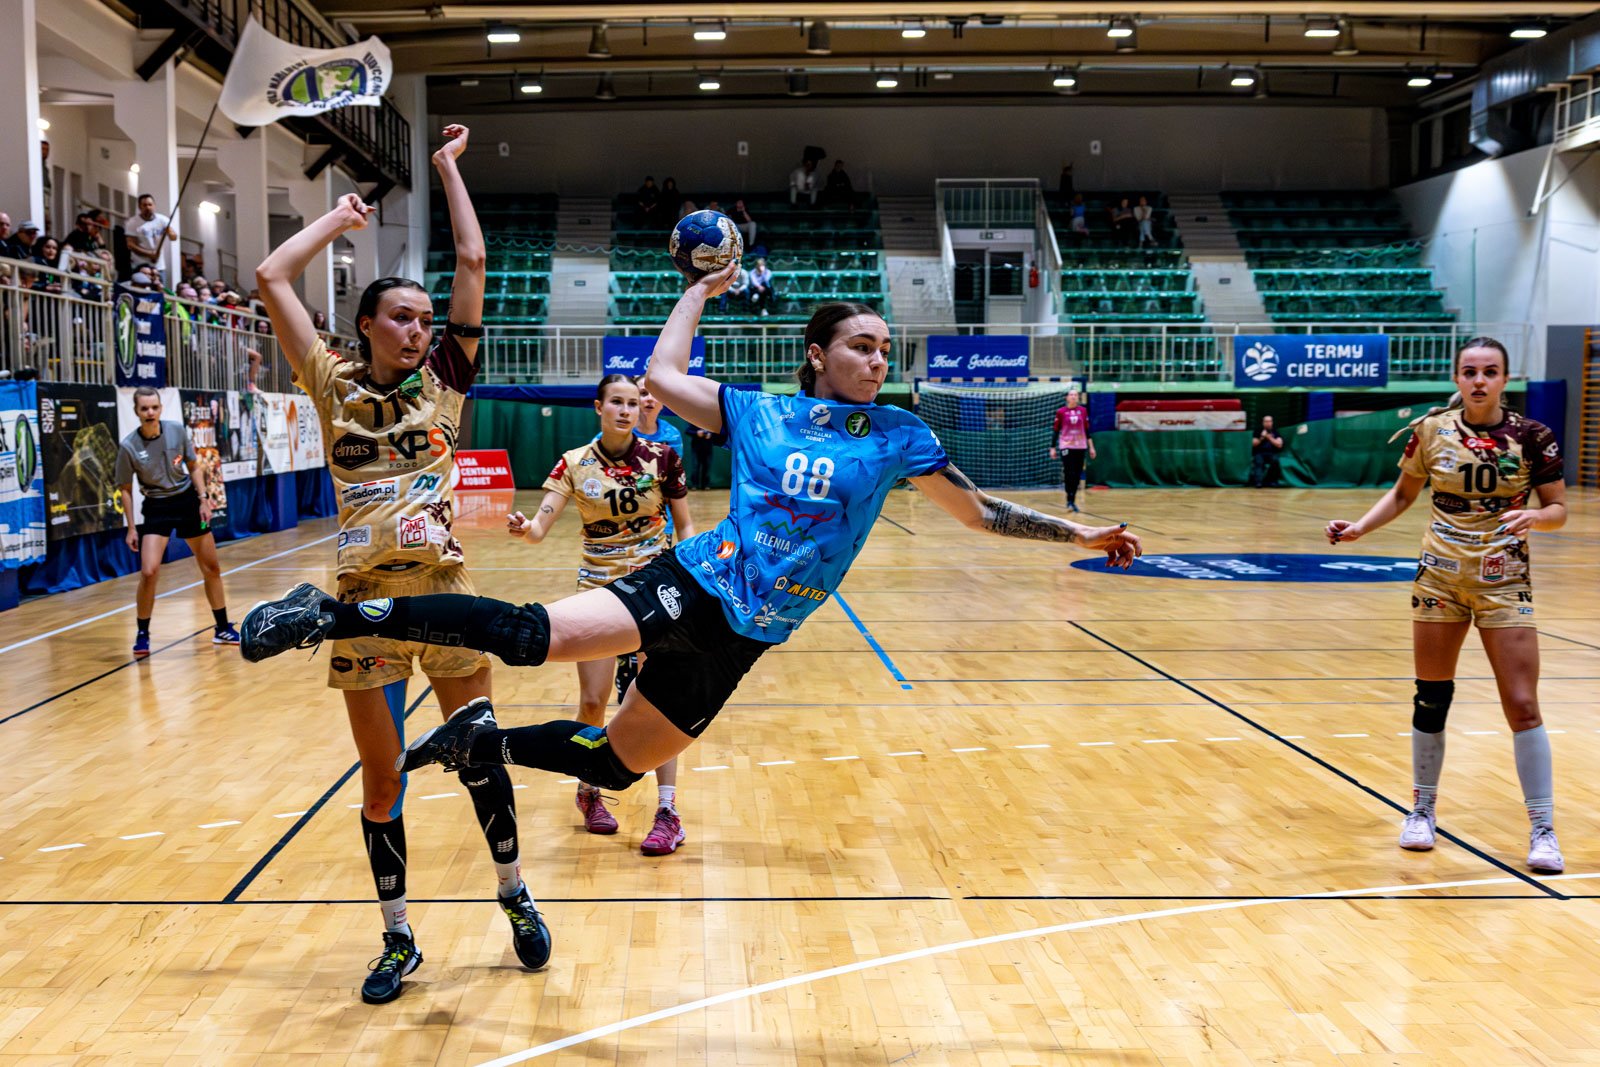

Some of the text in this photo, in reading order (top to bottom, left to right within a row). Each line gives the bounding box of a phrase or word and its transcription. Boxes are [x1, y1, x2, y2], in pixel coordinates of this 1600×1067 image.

[1304, 344, 1364, 359] TERMY
[604, 355, 640, 369] Hotel
[929, 354, 963, 368] Hotel
[1286, 362, 1380, 378] CIEPLICKIE
[800, 428, 832, 438] CENTRALNA
[335, 441, 371, 458] elmas
[388, 427, 447, 460] KPS
[457, 457, 479, 467] LIGA
[461, 466, 508, 476] CENTRALNA
[781, 451, 835, 501] 88
[1458, 463, 1498, 493] 10
[462, 476, 491, 486] KOBIET
[603, 488, 640, 516] 18
[753, 530, 791, 553] JELENIA
[356, 655, 386, 671] KPS
